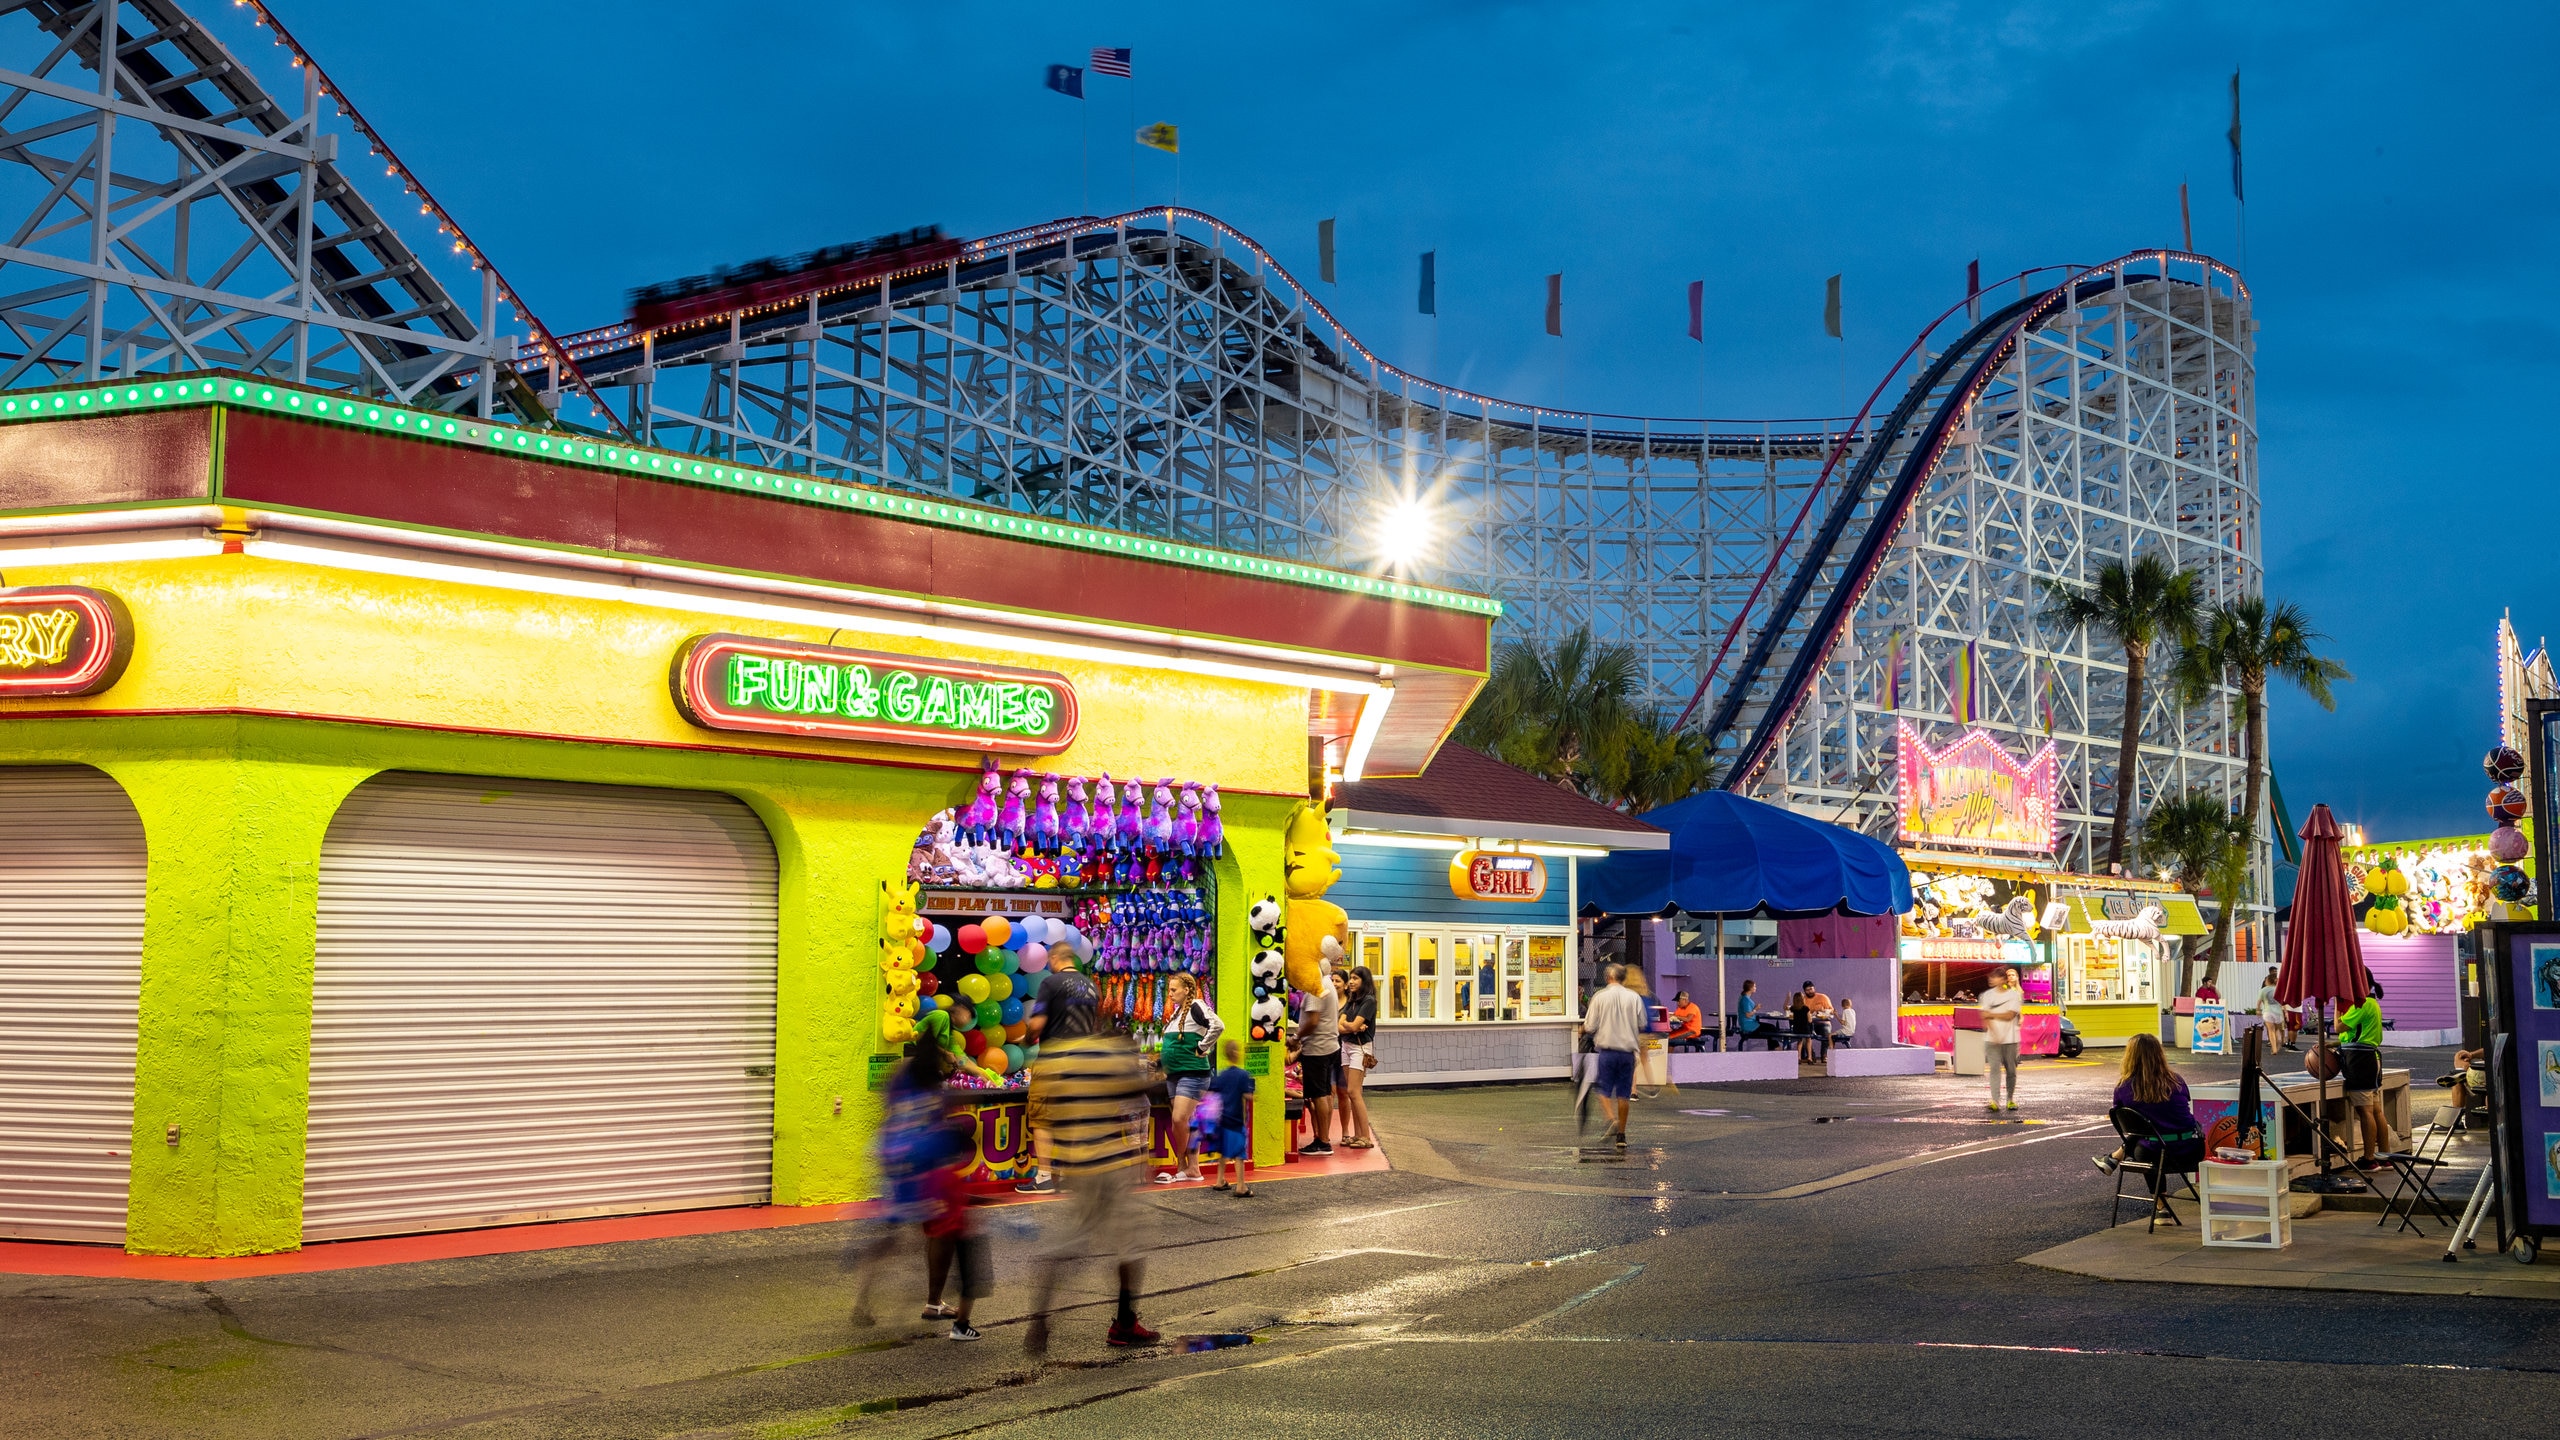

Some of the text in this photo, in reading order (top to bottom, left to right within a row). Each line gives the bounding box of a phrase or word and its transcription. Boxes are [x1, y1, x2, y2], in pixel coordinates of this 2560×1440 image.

[728, 653, 838, 715] FUN
[879, 670, 1055, 736] GAMES
[1952, 788, 1995, 838] Alley
[1470, 858, 1534, 894] GRILL
[927, 897, 956, 910] KIDS
[958, 898, 989, 911] PLAY
[1010, 899, 1038, 912] THEY
[1040, 900, 1063, 913] WIN
[2110, 900, 2128, 915] ICE
